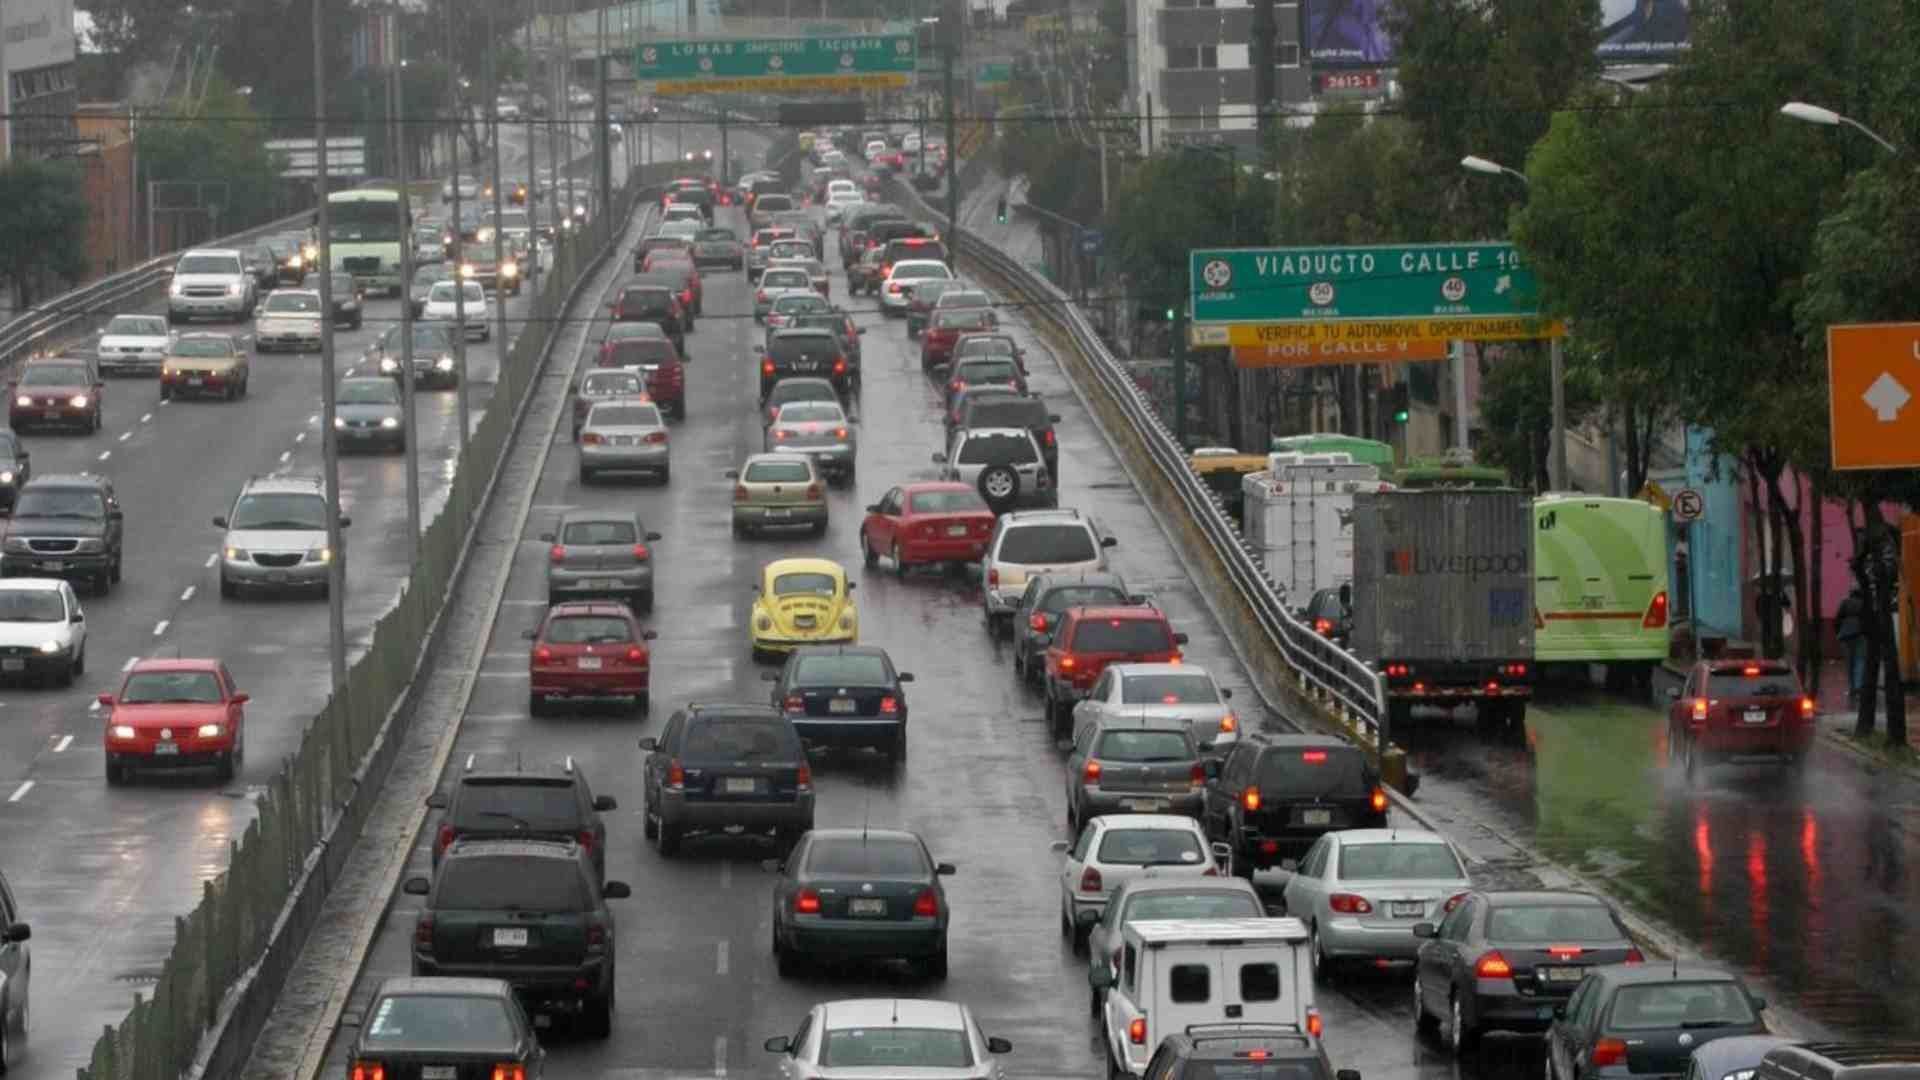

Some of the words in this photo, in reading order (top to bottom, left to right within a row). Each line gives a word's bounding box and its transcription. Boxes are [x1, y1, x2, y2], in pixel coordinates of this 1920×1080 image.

[1255, 253, 1375, 275] VIADUCTO
[1400, 250, 1480, 273] CALLE
[1256, 325, 1315, 342] VERIFICA
[1324, 324, 1340, 339] TU
[1347, 320, 1422, 339] AUTOMOVIL
[1267, 342, 1311, 357] POR
[1320, 339, 1388, 354] CALLE
[1414, 547, 1528, 583] Liverpool
